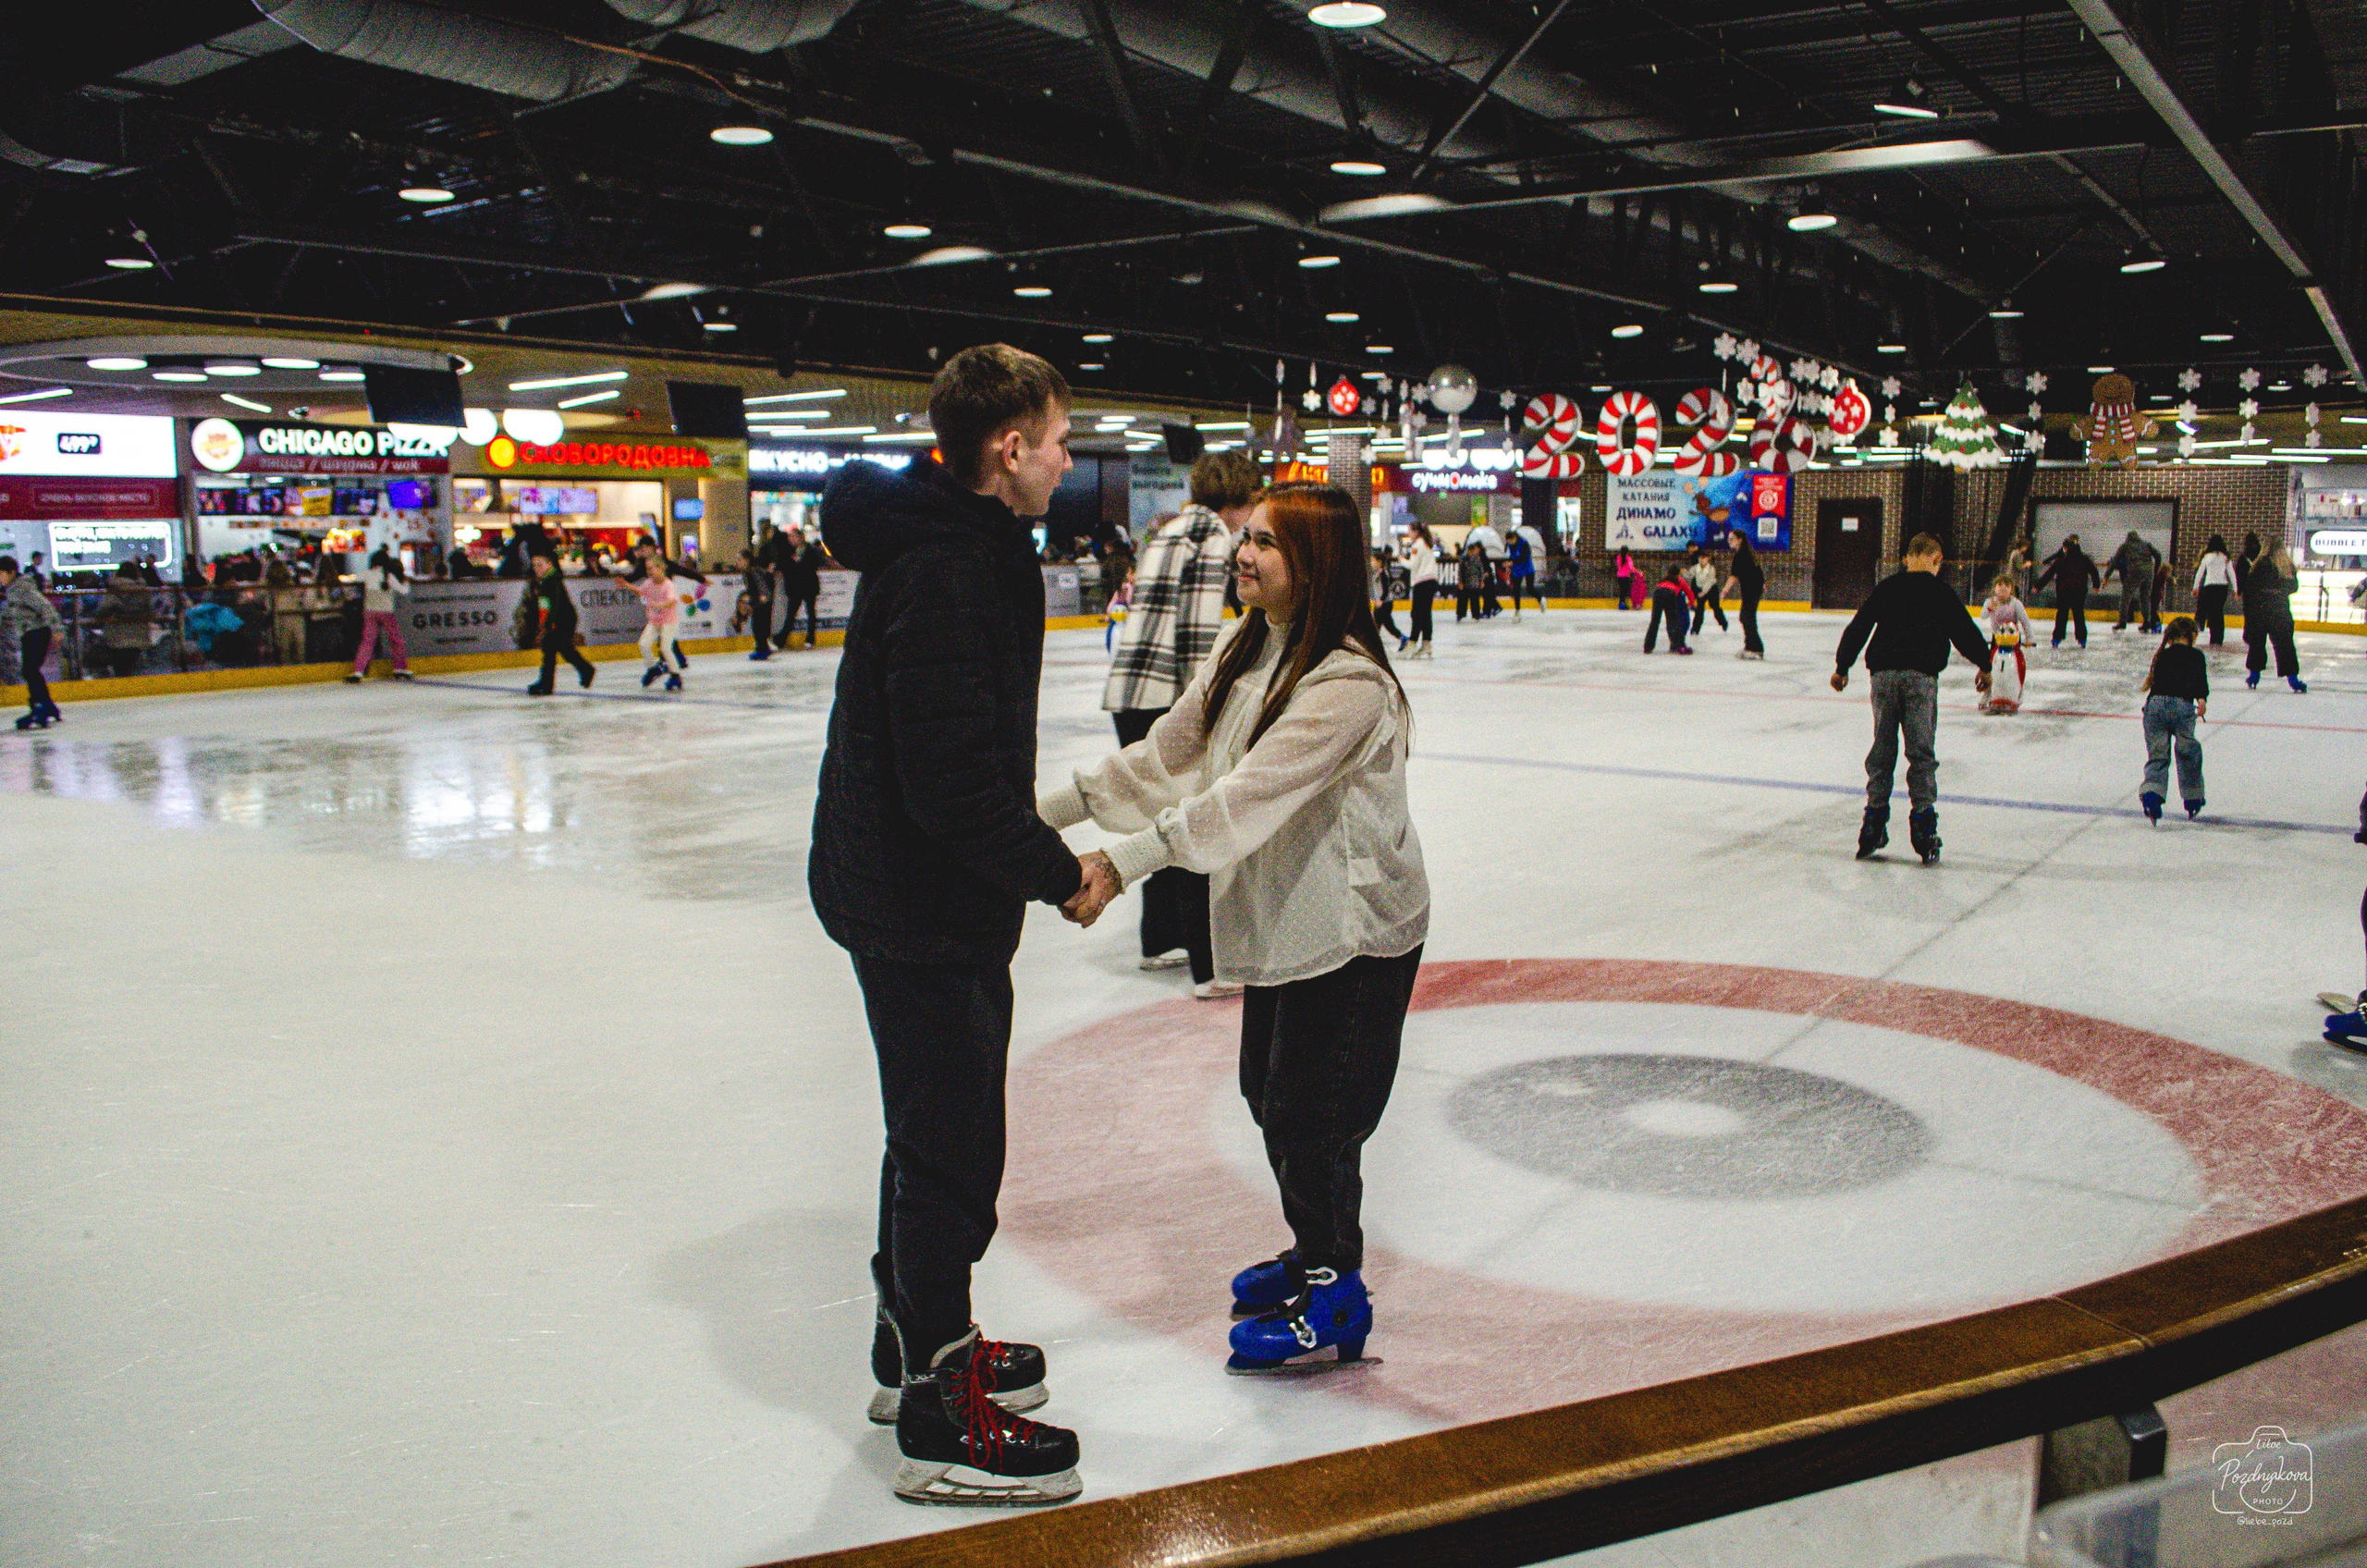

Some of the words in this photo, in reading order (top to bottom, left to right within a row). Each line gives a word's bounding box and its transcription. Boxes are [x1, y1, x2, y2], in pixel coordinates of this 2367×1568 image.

[259, 428, 374, 455] CHICAGO
[748, 449, 828, 473] ВКУСНО
[1618, 477, 1676, 488] МАССОВЫЕ
[1623, 492, 1670, 502] КАТАНИЯ
[1616, 507, 1676, 521] ДИНАМО
[412, 610, 497, 630] GRESSO
